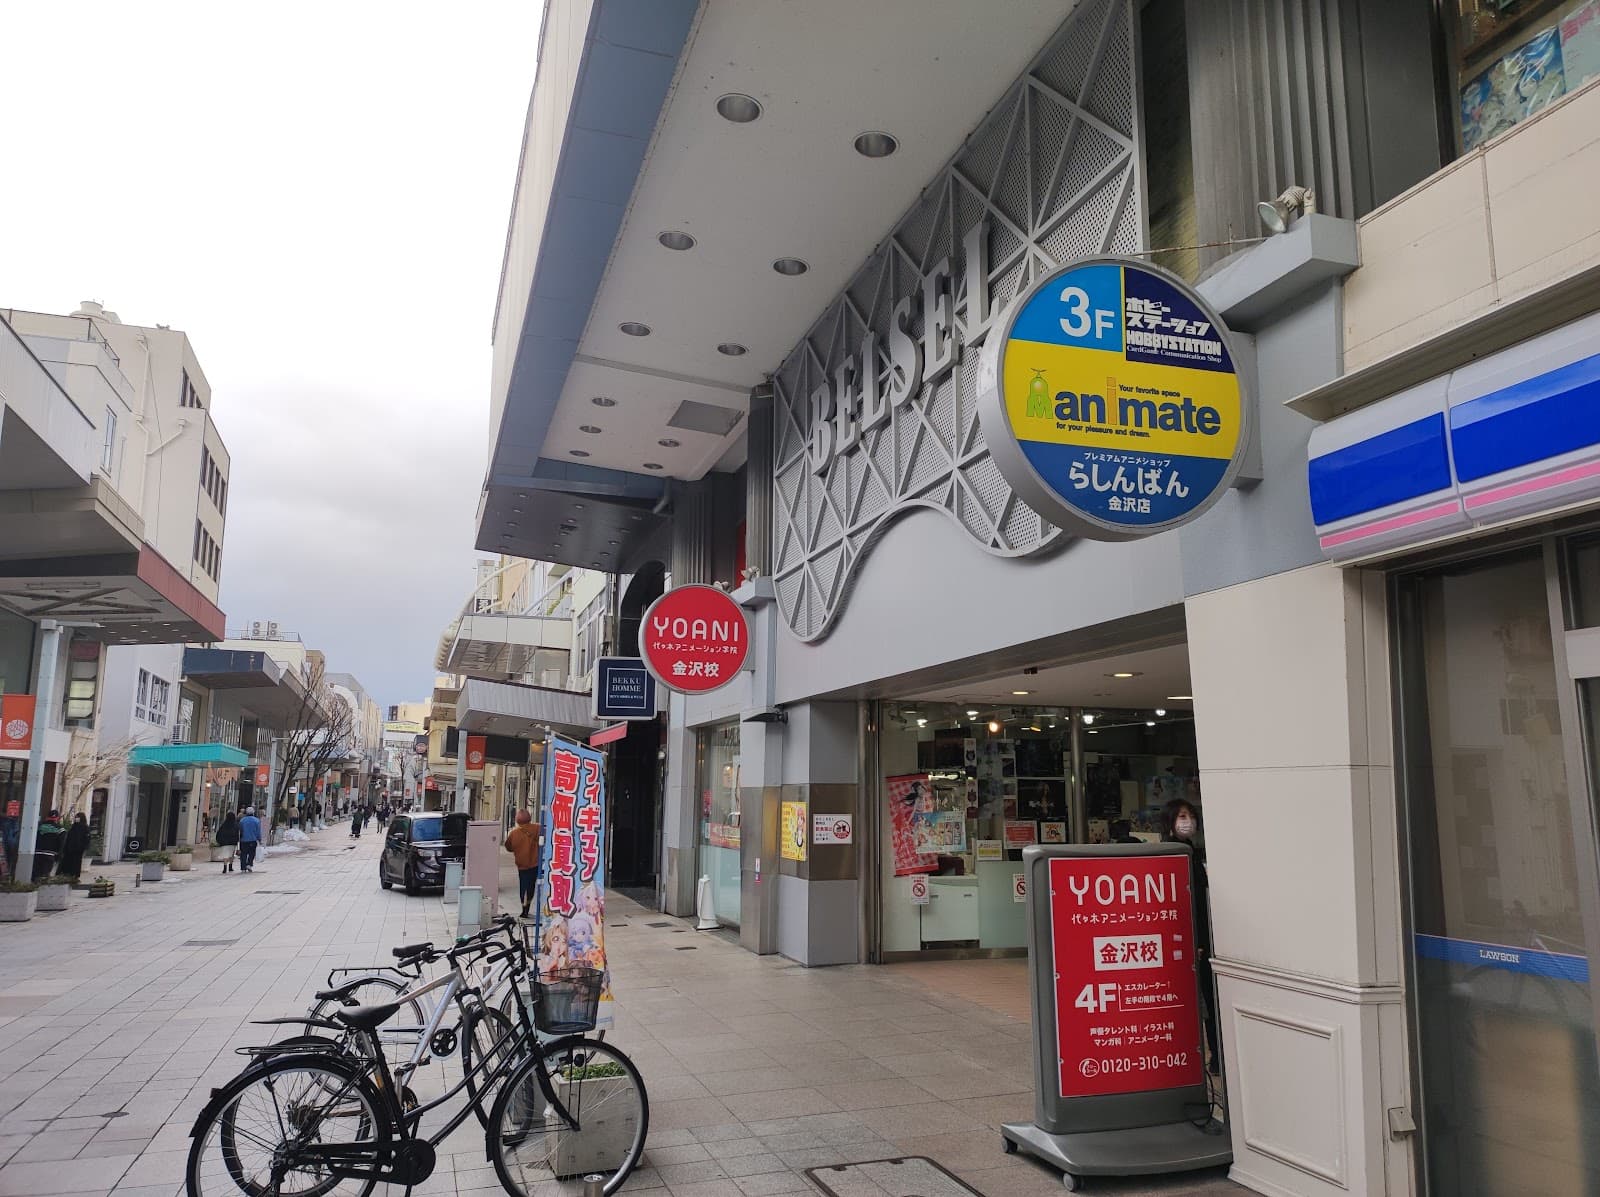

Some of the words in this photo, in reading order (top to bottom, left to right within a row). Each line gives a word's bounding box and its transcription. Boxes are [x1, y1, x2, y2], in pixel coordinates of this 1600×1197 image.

[1060, 286, 1115, 339] 3F
[1126, 297, 1171, 316] ホビー
[1126, 312, 1210, 336] ステーション
[811, 220, 1000, 475] BELSEL
[1119, 384, 1134, 393] Your
[1135, 386, 1160, 396] favorite
[1161, 390, 1180, 398] space
[1054, 377, 1221, 436] animate
[1068, 424, 1083, 432] your
[1085, 425, 1113, 434] pleasure
[1115, 428, 1127, 436] and
[1084, 452, 1171, 467] プレミアムアニメショップ
[1069, 461, 1189, 498] らしんばん
[1108, 496, 1151, 514] 金沢店
[653, 616, 739, 642] YOANI
[653, 642, 738, 655] 代々木アニメーション学院
[672, 660, 720, 677] 金沢校
[612, 676, 641, 685] BEKKU
[612, 684, 641, 692] HOMME
[576, 758, 600, 881] フィギュア
[548, 750, 581, 917] 高価買取
[1069, 873, 1177, 906] YOANI
[1072, 909, 1178, 925] 代々木アニメーション学院
[1100, 941, 1159, 964] 金沢校
[1479, 949, 1520, 964] LAWSON
[1075, 982, 1117, 1014] 4F
[1101, 1052, 1187, 1073] 0120-310-042
